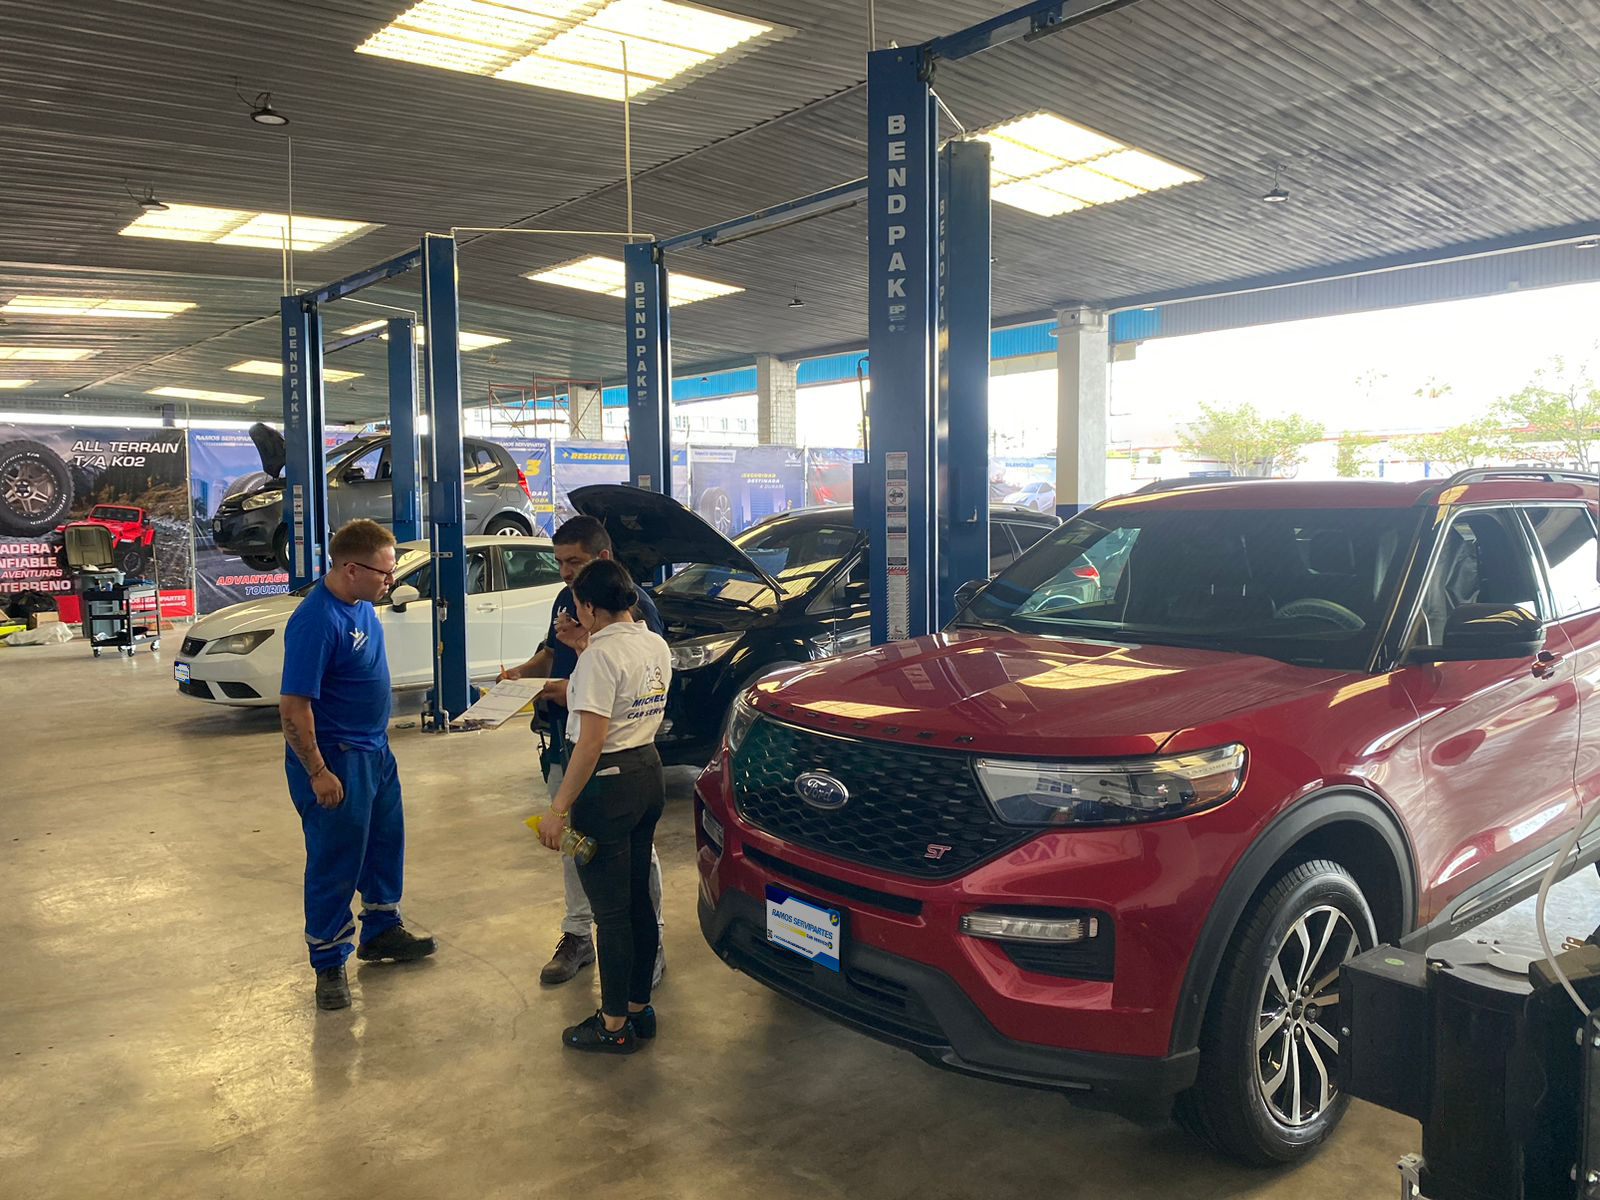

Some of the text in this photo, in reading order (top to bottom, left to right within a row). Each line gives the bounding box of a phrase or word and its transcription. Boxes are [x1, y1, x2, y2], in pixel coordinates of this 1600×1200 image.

[887, 114, 906, 298] BENDPAK
[634, 281, 647, 388] BENDPAK
[288, 327, 299, 413] BENDPAK
[71, 440, 179, 454] ALL TERRAIN
[74, 455, 107, 469] T/A
[571, 453, 625, 461] RESISTENTE
[525, 459, 541, 476] 3
[53, 545, 63, 553] Y
[1, 569, 63, 579] AVENTURAS
[216, 573, 289, 586] ADVANTAGE
[0, 580, 72, 593] TERRENO
[627, 710, 644, 720] CAR
[803, 778, 835, 801] Ford
[924, 844, 952, 860] ST
[771, 908, 834, 940] RAMOS SERVIPARTES
